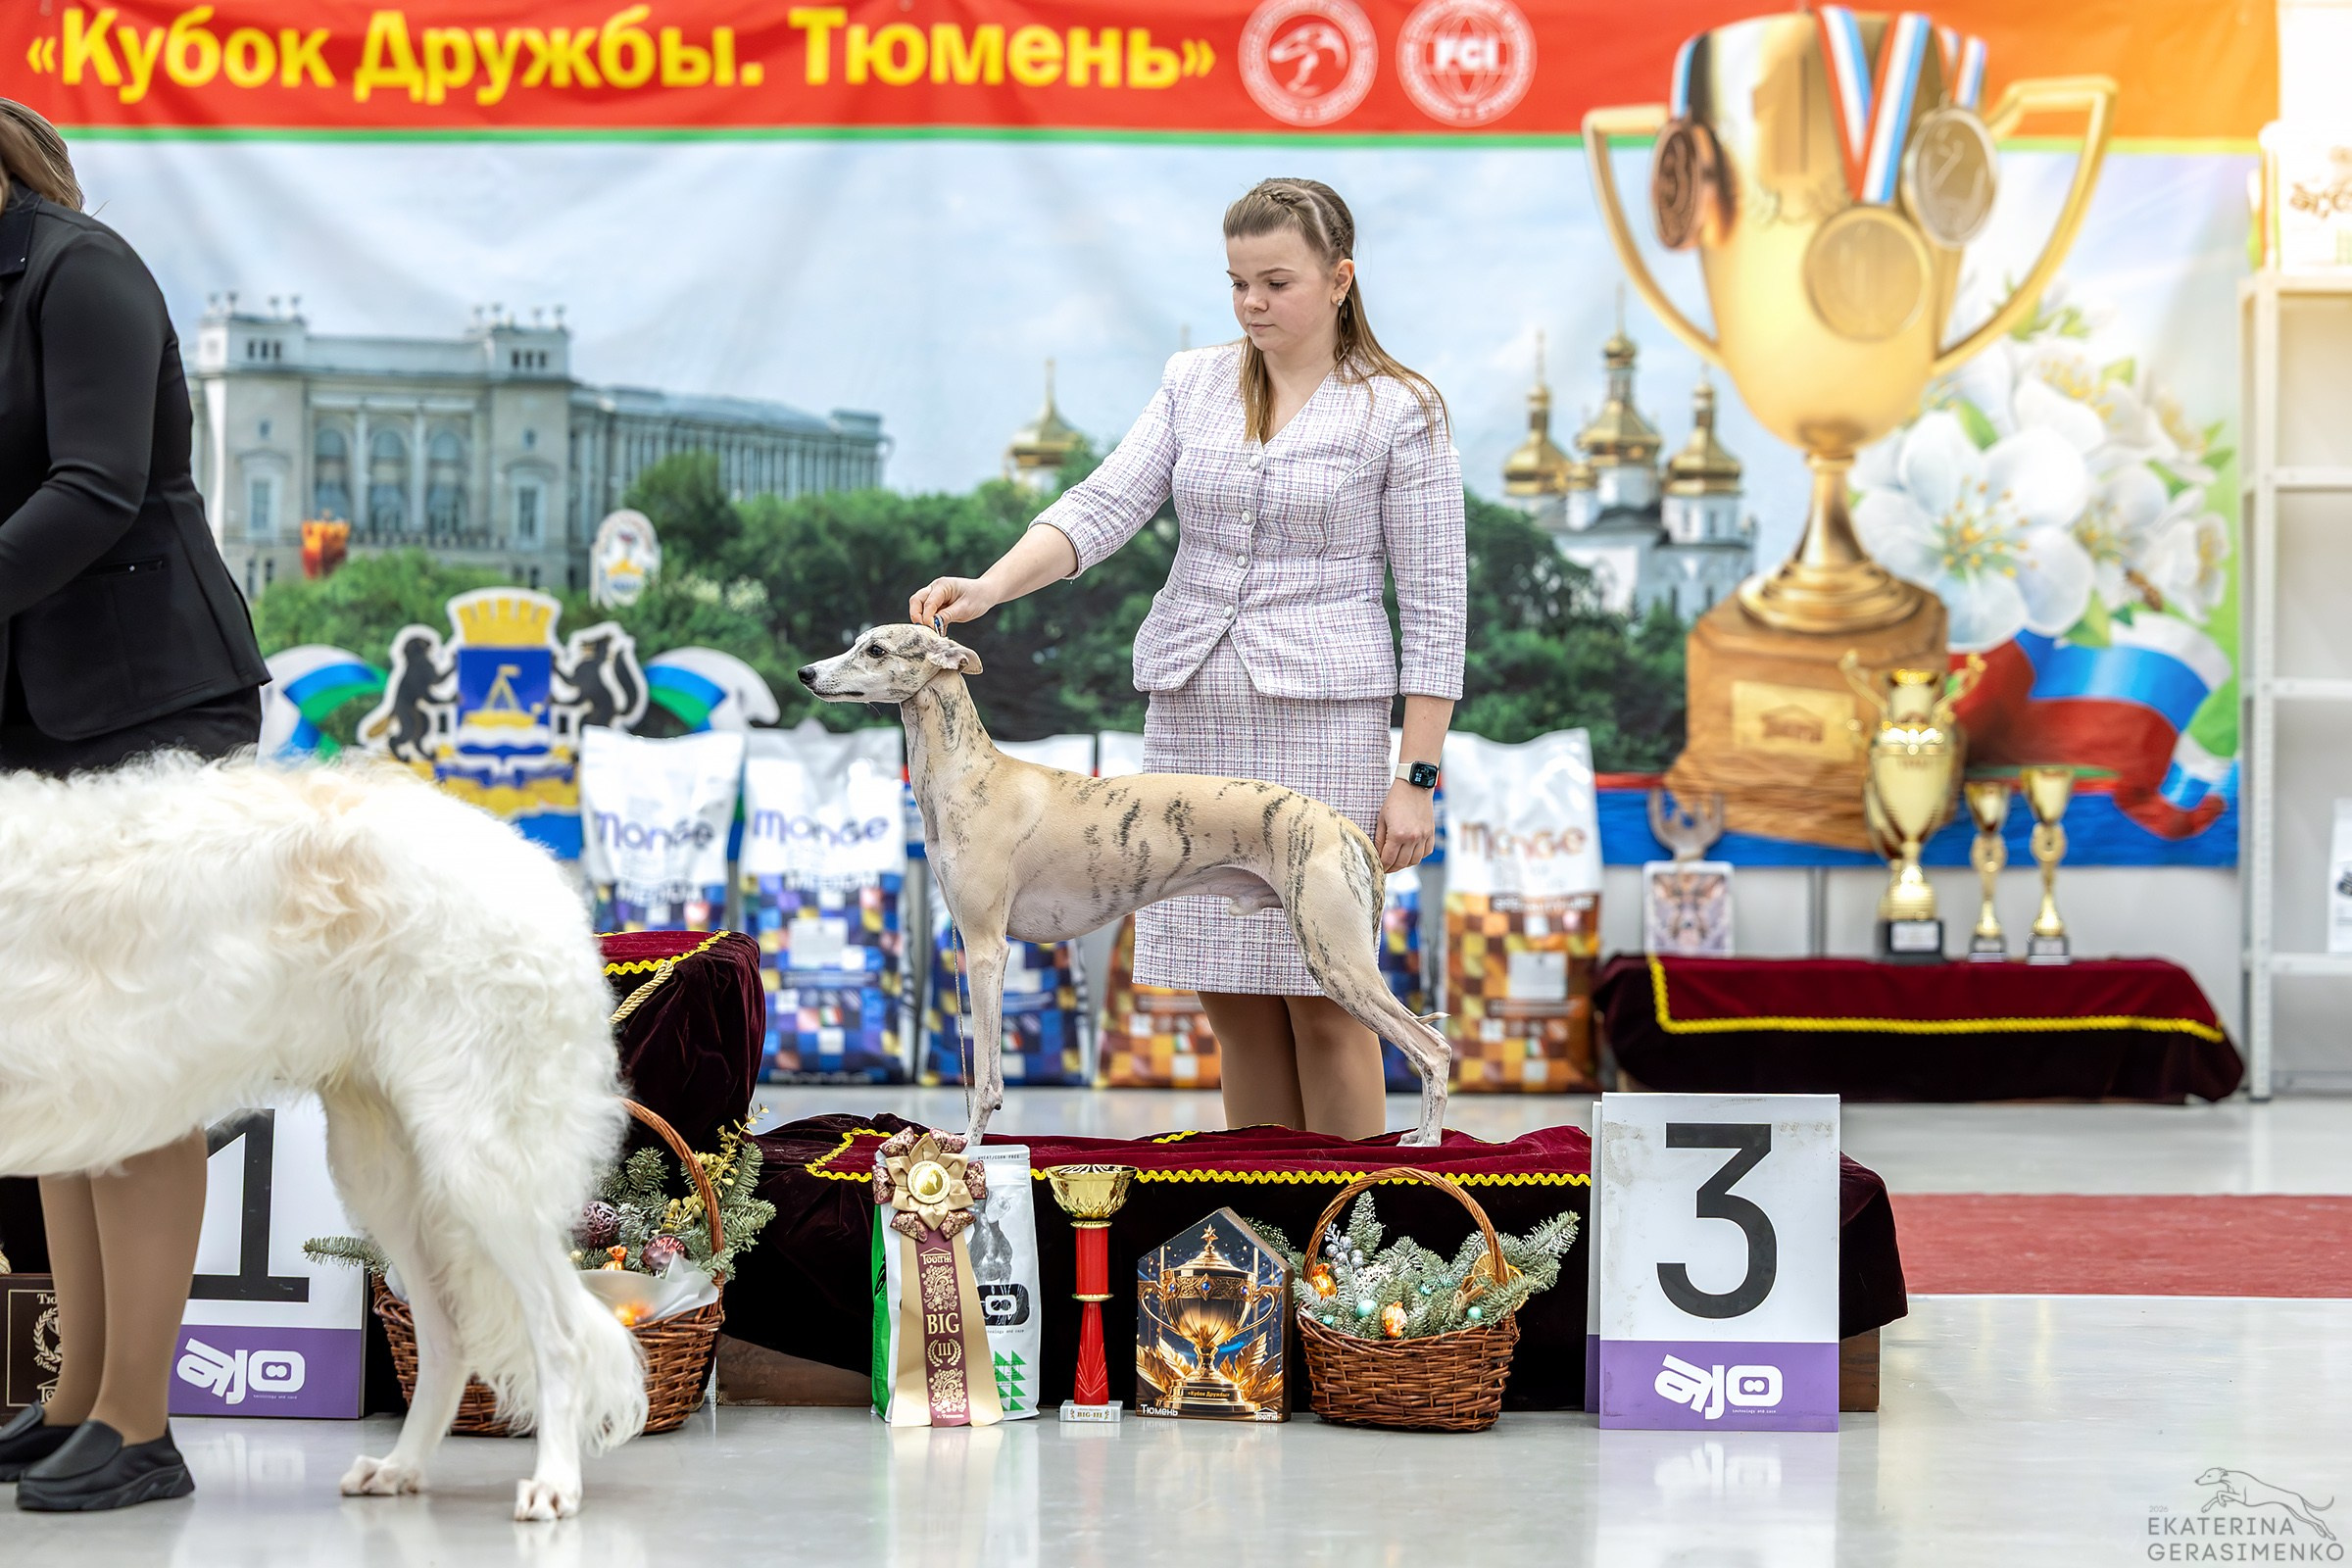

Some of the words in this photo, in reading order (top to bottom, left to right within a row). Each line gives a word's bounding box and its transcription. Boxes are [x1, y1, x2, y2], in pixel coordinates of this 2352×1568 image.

[27, 5, 335, 103] «Кубок
[354, 4, 764, 105] Дружбы.
[789, 7, 1215, 88] Тюмень»
[1435, 37, 1499, 71] FCI
[187, 1107, 310, 1301] 1
[1656, 1123, 1778, 1319] 3
[926, 1312, 959, 1334] BIG
[938, 1343, 952, 1356] III
[1140, 1403, 1179, 1417] Тюмень
